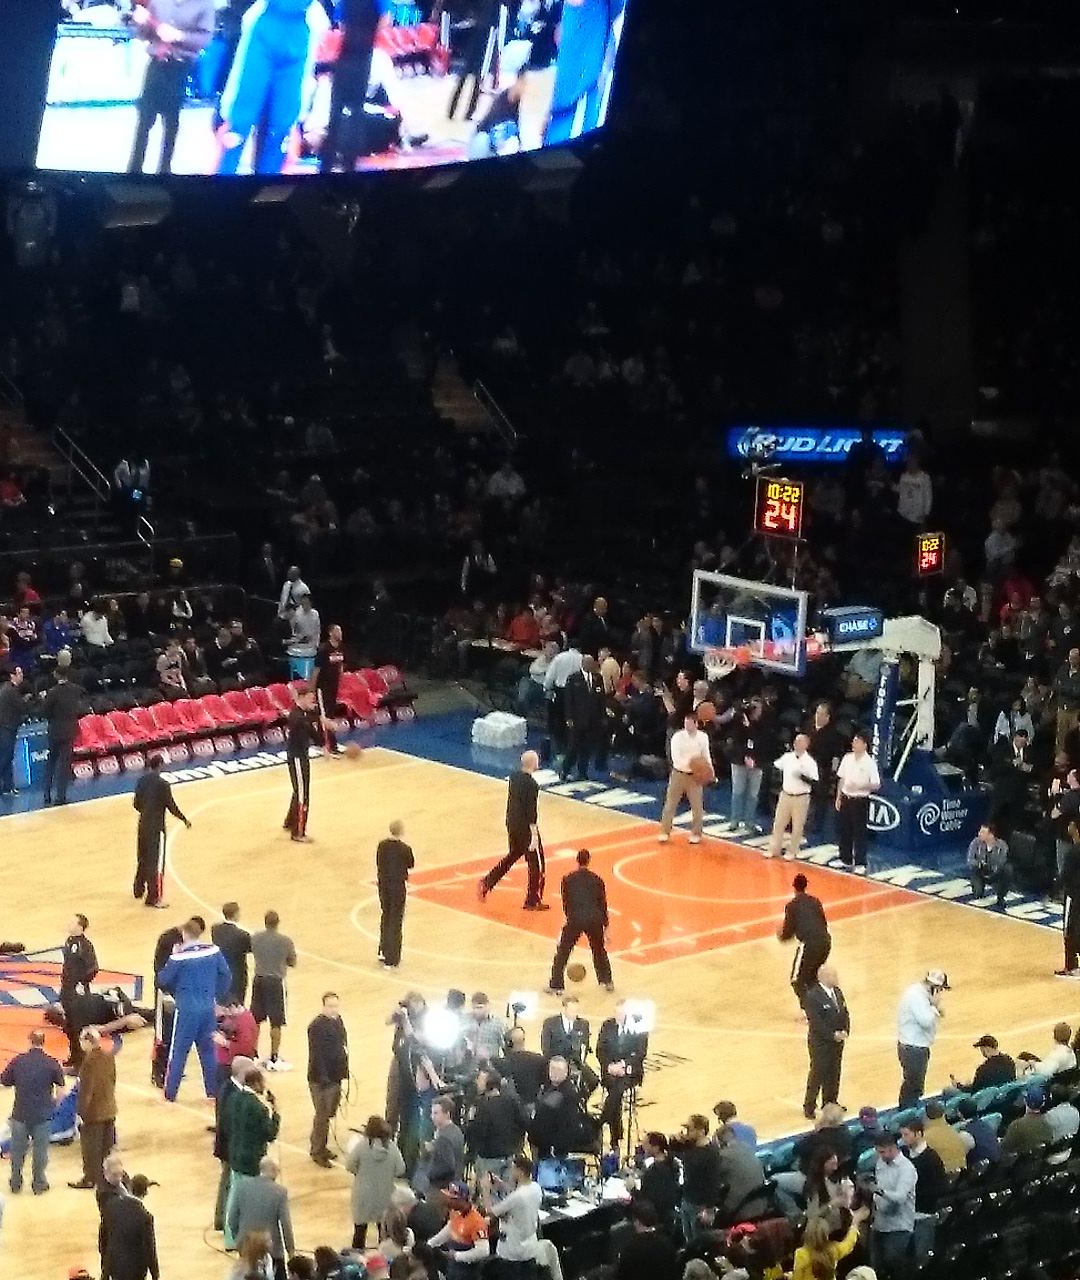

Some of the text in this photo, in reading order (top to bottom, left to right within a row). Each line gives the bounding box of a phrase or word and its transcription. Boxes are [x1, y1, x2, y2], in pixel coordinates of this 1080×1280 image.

[768, 483, 800, 503] 10:22
[763, 500, 797, 530] 24
[921, 551, 938, 568] 24
